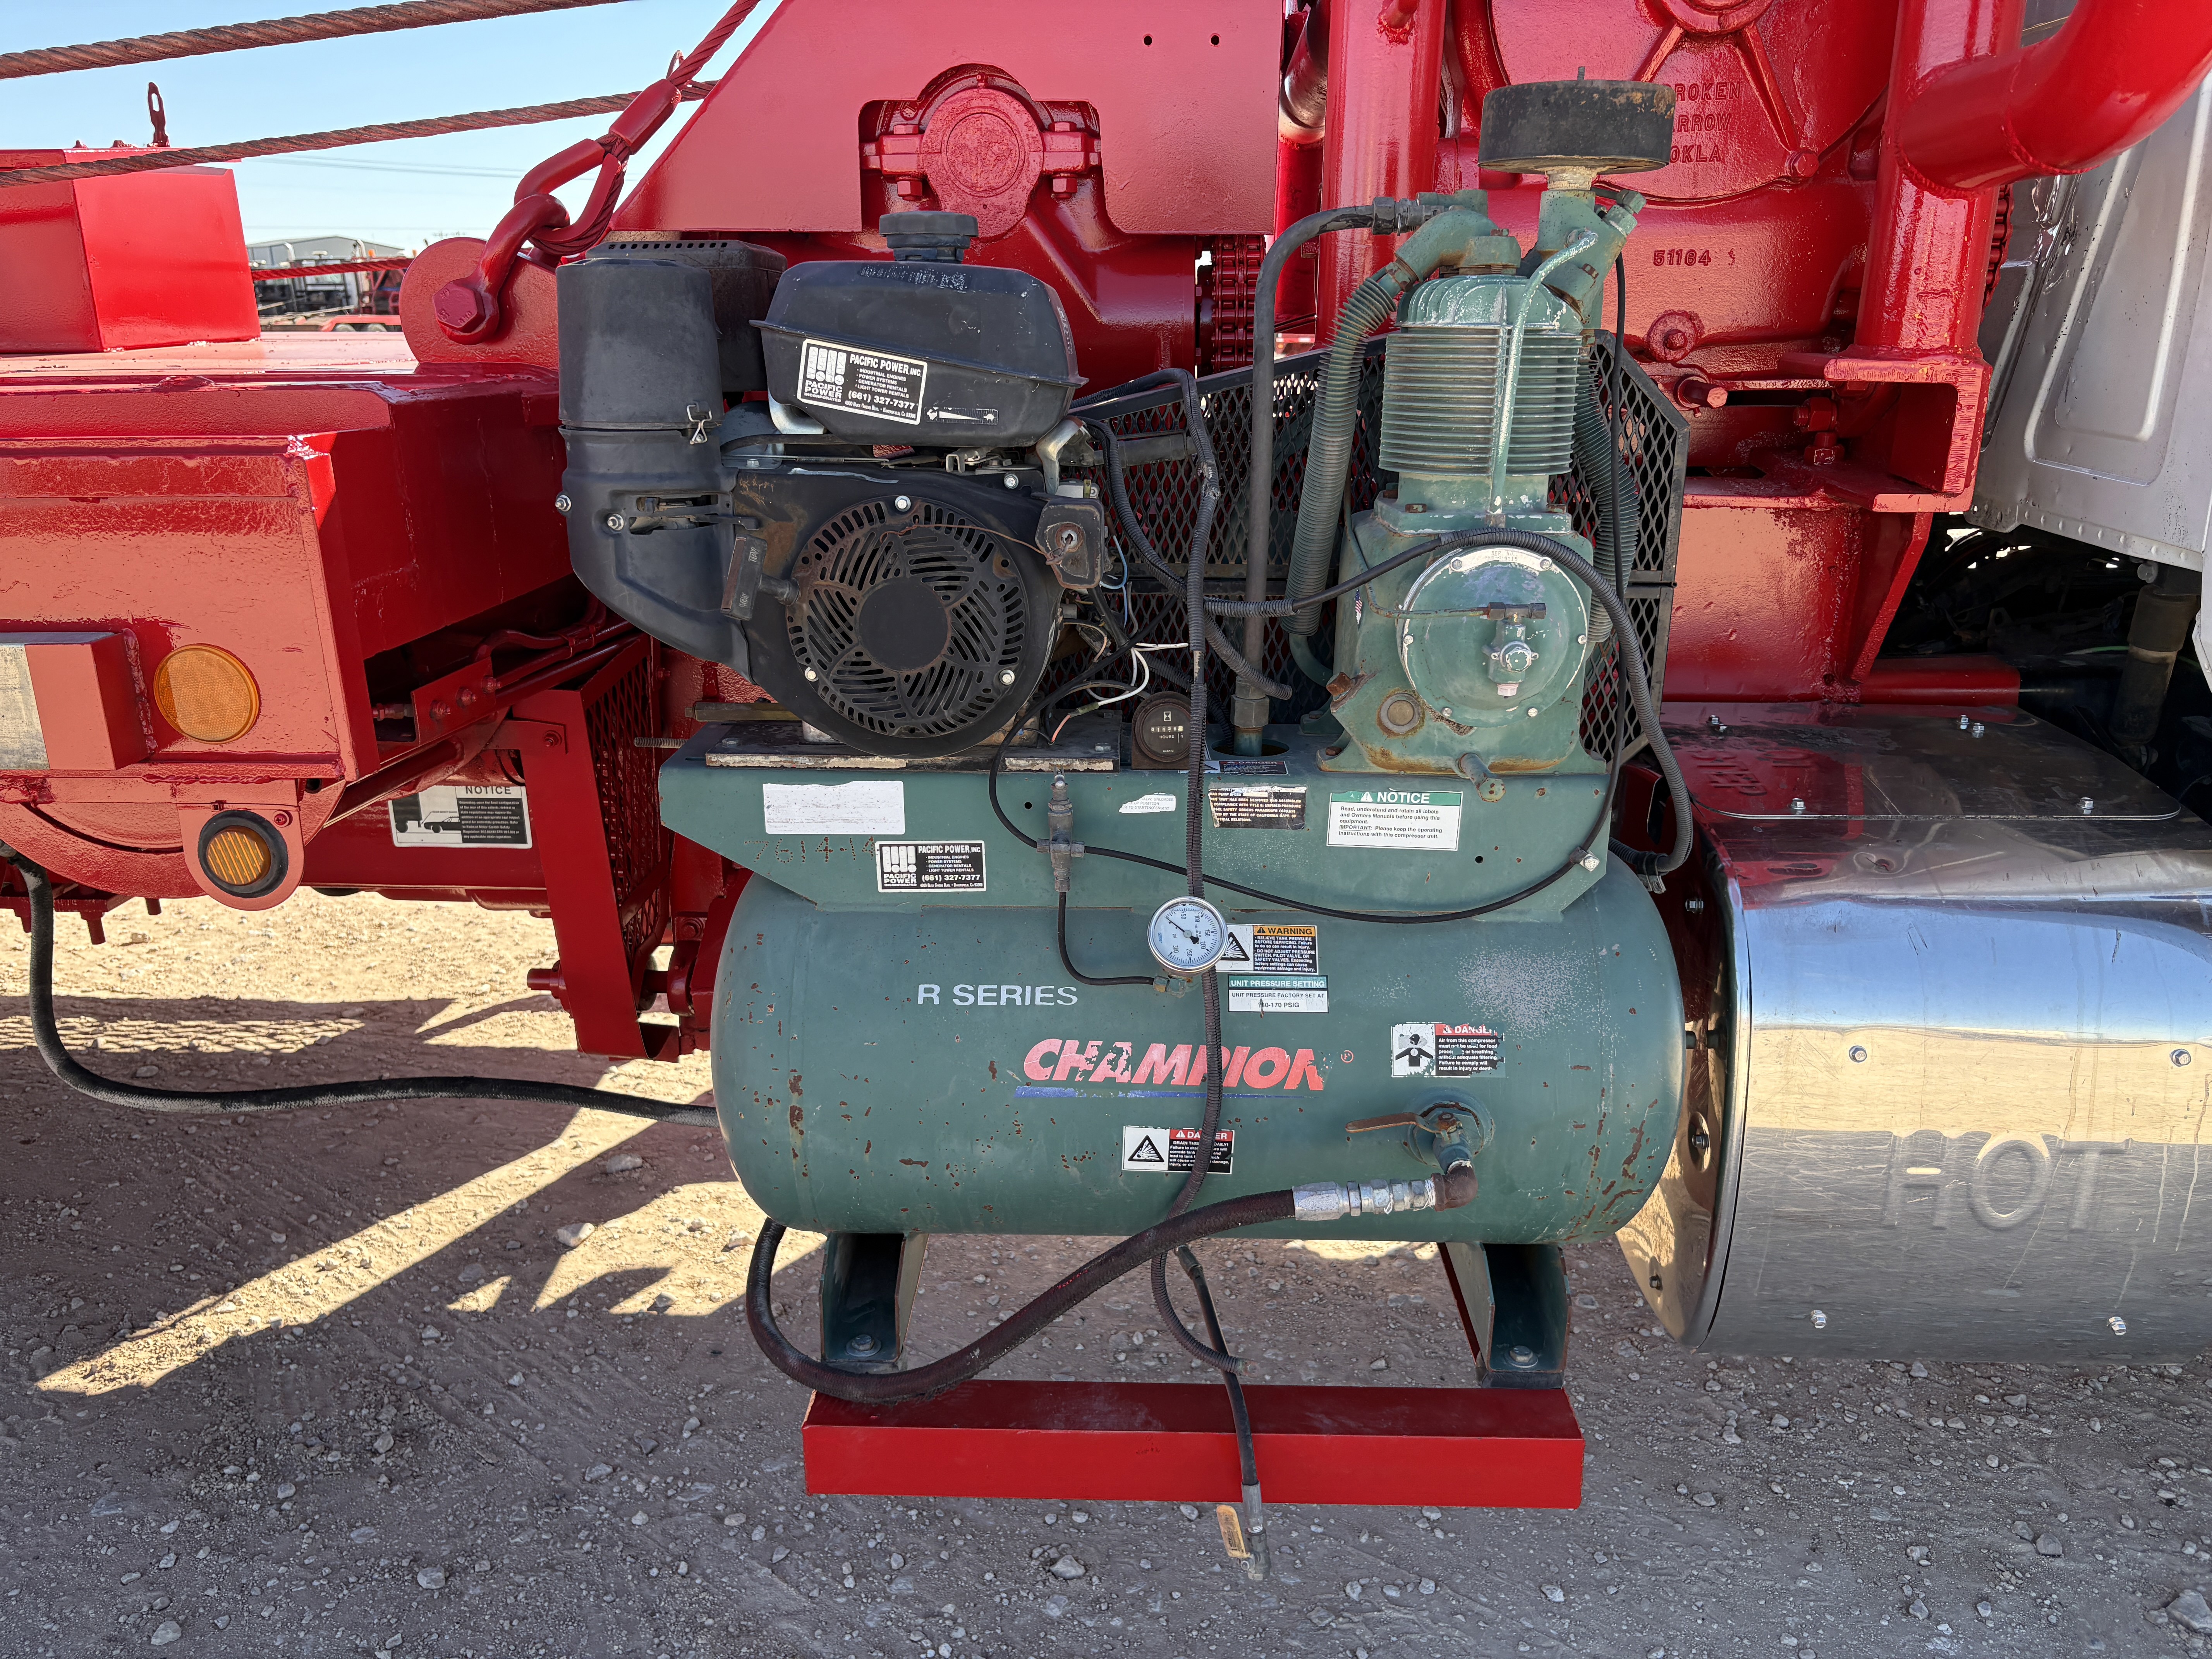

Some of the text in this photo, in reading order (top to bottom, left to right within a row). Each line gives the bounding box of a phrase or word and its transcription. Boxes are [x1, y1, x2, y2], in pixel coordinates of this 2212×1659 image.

[1668, 82, 1741, 101] ROKEN
[1673, 113, 1732, 132] RROW
[1669, 146, 1723, 163] OKLA
[850, 354, 878, 368] PACIFIC
[860, 368, 885, 377] INDUSTRIAL
[805, 380, 842, 392] PACIFIC
[858, 379, 886, 388] GENERATOR
[804, 392, 841, 402] INCORPORATED
[805, 386, 842, 398] POWER
[848, 390, 915, 410] (661) 327-7377
[1377, 792, 1429, 803] NOTICE
[918, 984, 1079, 1006] R SERIES
[1881, 1131, 2131, 1233] HOT
